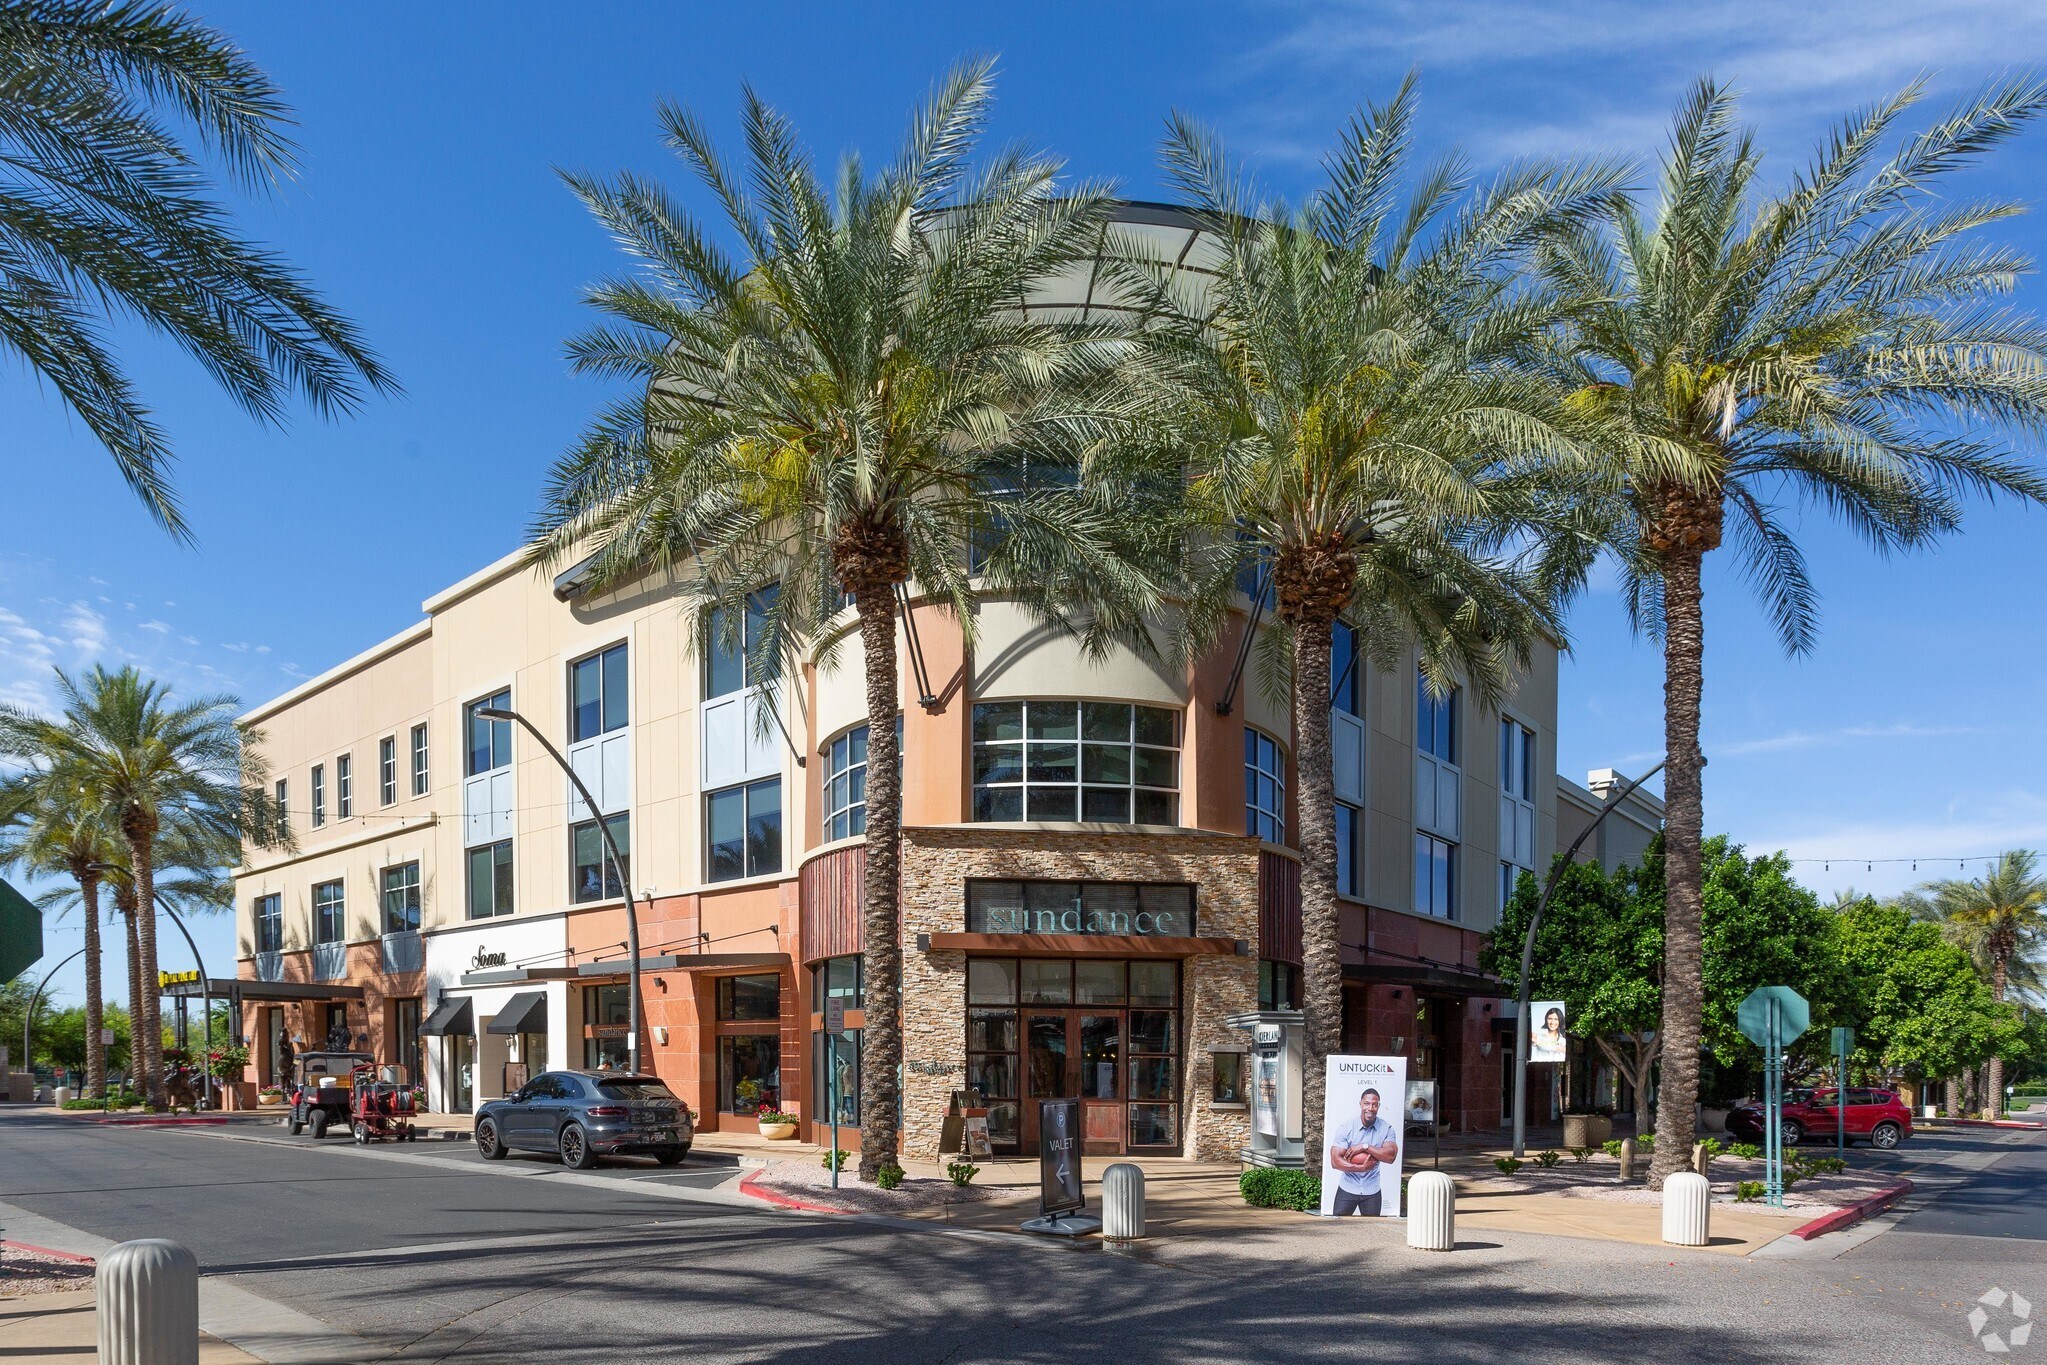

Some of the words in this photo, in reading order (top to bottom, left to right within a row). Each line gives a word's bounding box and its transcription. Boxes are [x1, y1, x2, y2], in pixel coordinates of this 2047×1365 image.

[990, 897, 1173, 933] sundance
[471, 944, 507, 968] Soma
[1049, 1137, 1074, 1151] VALET
